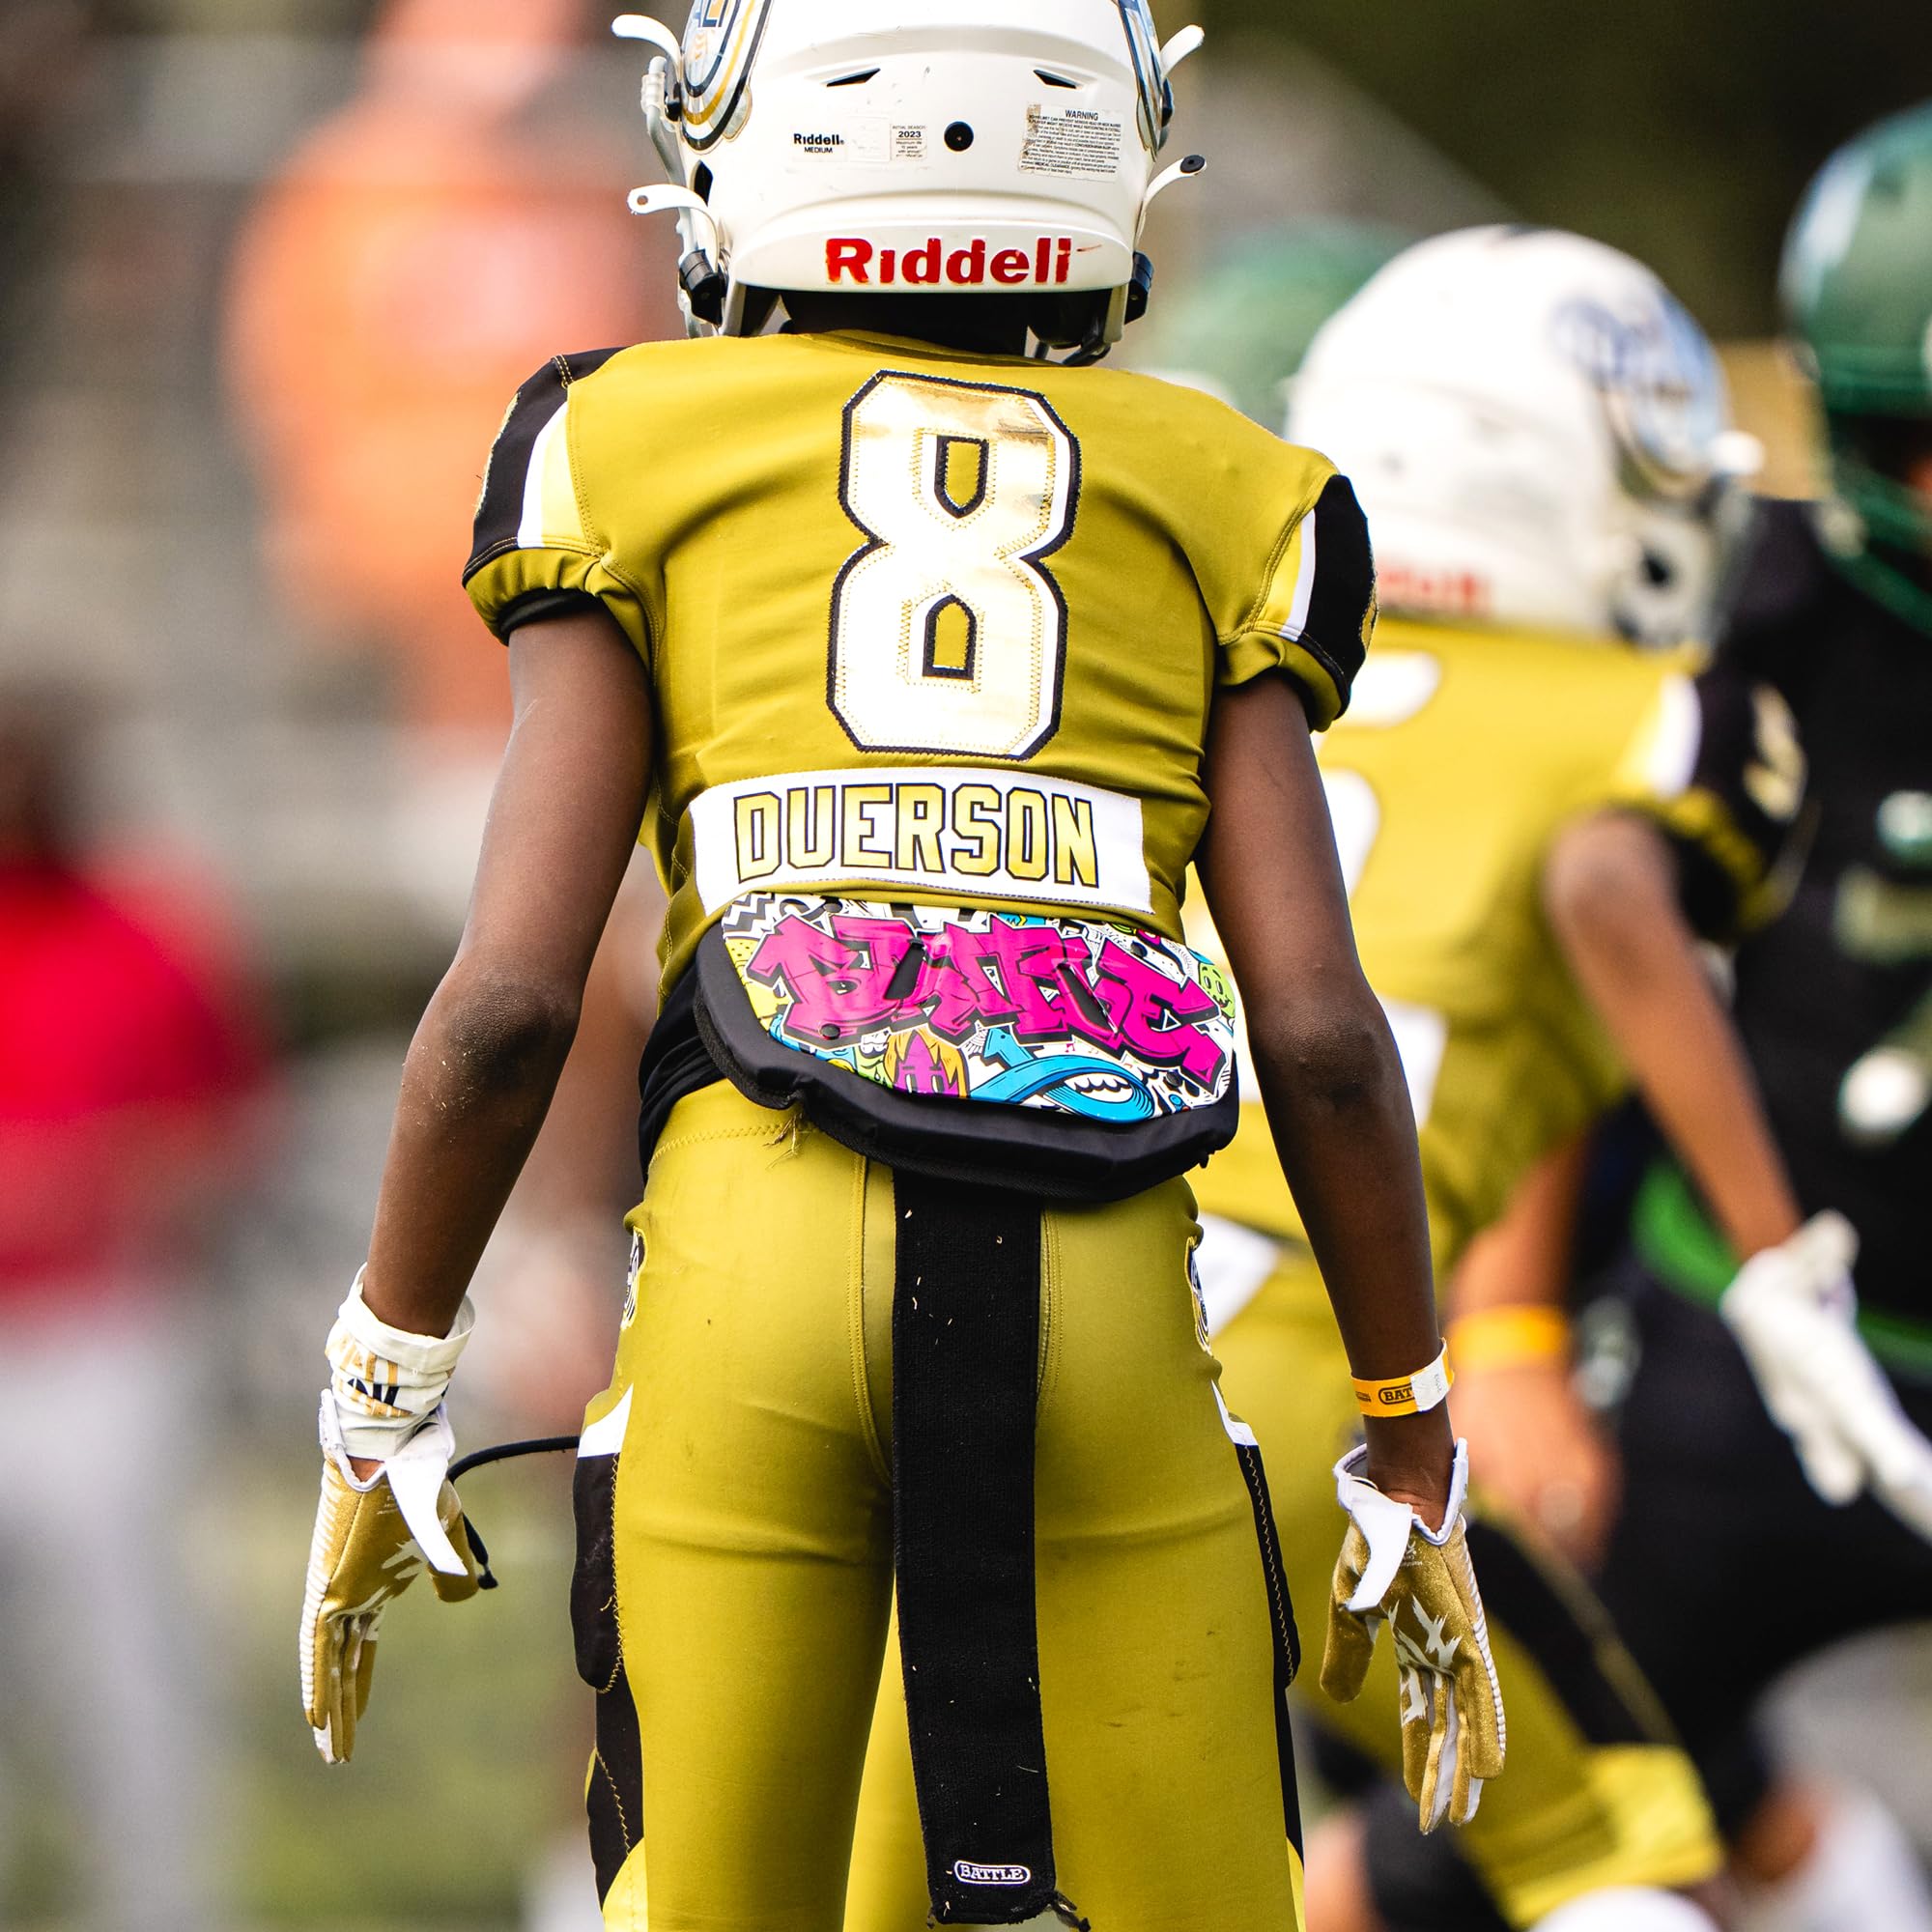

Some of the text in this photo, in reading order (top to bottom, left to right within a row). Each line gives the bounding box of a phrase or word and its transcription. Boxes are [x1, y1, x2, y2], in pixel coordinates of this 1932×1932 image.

[1065, 109, 1099, 121] WARNING
[793, 132, 841, 145] Riddell
[826, 370, 1082, 762] 8
[733, 782, 1099, 889] DUERSON
[1383, 1387, 1413, 1402] BAT
[959, 1864, 1025, 1881] BATTLE
